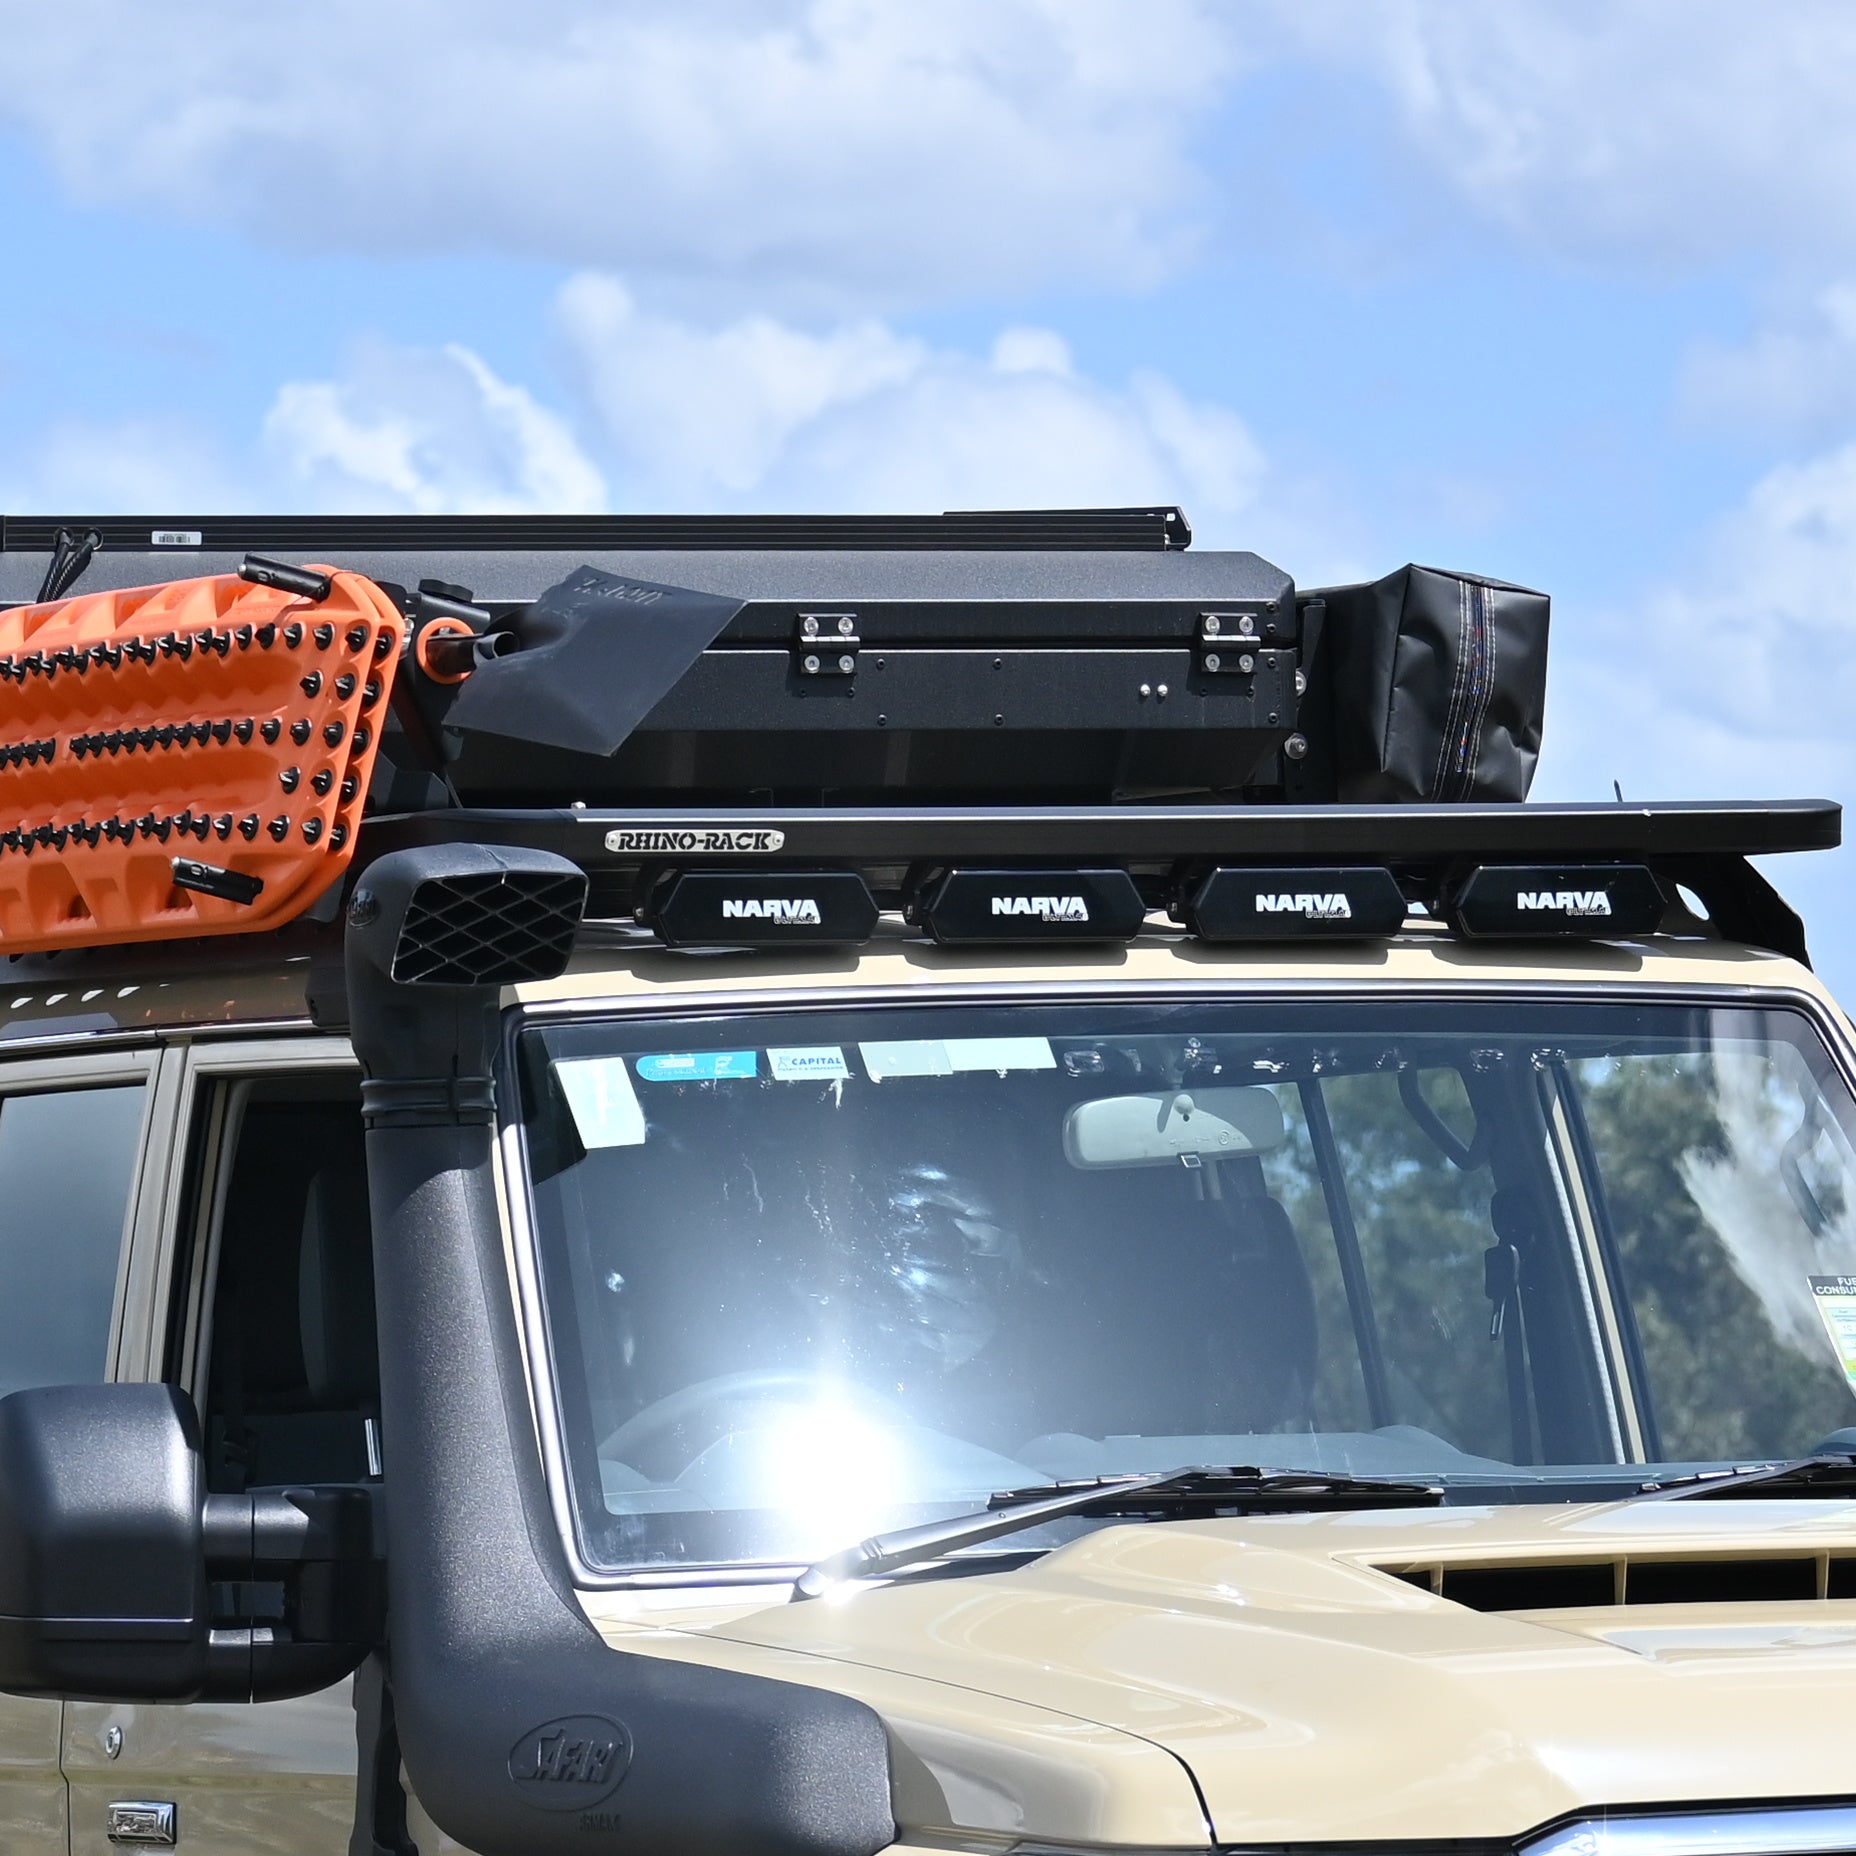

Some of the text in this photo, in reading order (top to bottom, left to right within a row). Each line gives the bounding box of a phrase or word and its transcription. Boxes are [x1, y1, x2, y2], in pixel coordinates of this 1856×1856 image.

[617, 832, 772, 850] RHINO-RACK
[723, 899, 821, 918] NARVA
[991, 896, 1088, 915] NARVA
[1256, 893, 1351, 912] NARVA
[1517, 891, 1611, 910] NARVA
[791, 1057, 842, 1066] CAPITAL
